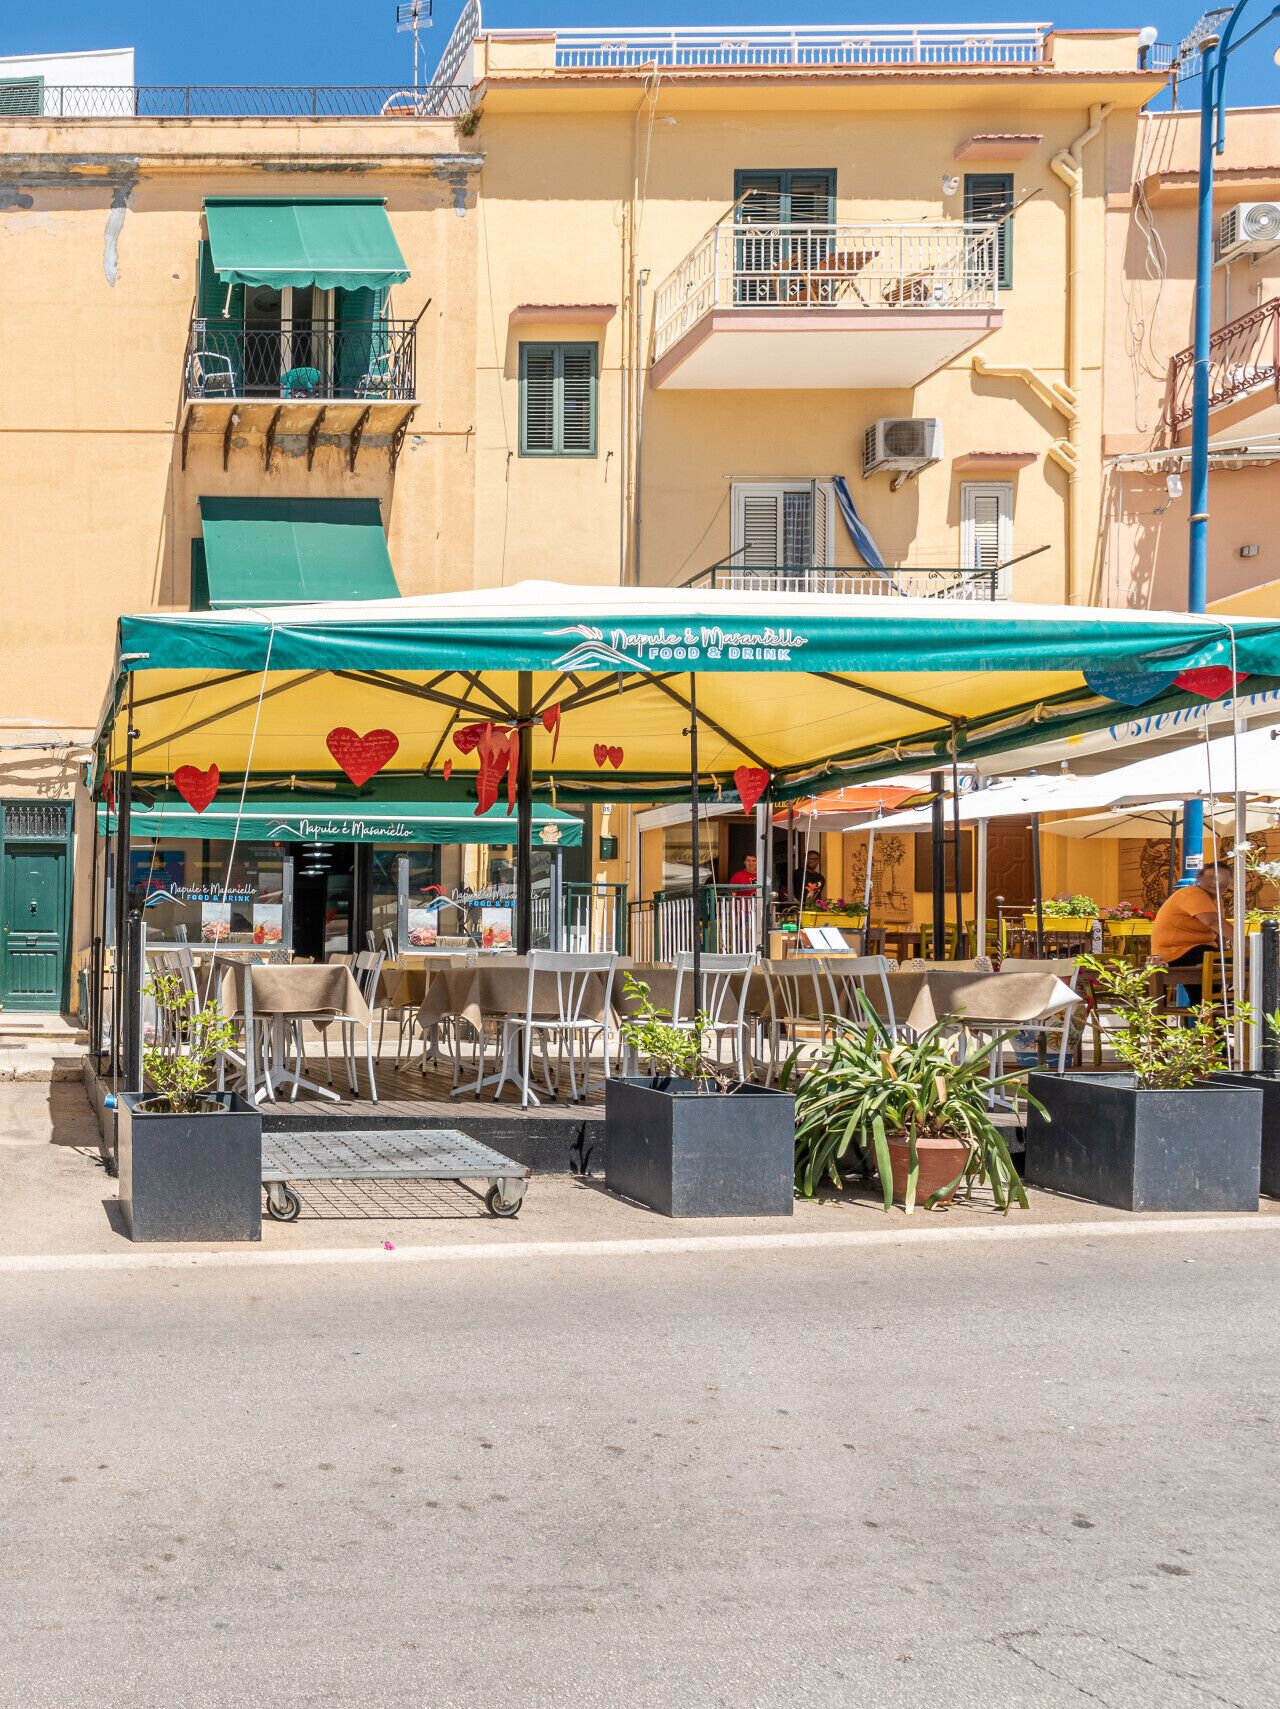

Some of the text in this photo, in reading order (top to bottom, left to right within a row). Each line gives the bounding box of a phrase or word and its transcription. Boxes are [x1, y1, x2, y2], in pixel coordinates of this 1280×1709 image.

[610, 627, 682, 658] Napule
[700, 626, 809, 648] Masaniello
[648, 646, 792, 661] FOOD & DRINK
[300, 819, 341, 840] Napule
[351, 820, 414, 838] Masaniello
[170, 881, 202, 899] Napule
[210, 882, 258, 897] Maaniello
[468, 900, 492, 908] FOOD
